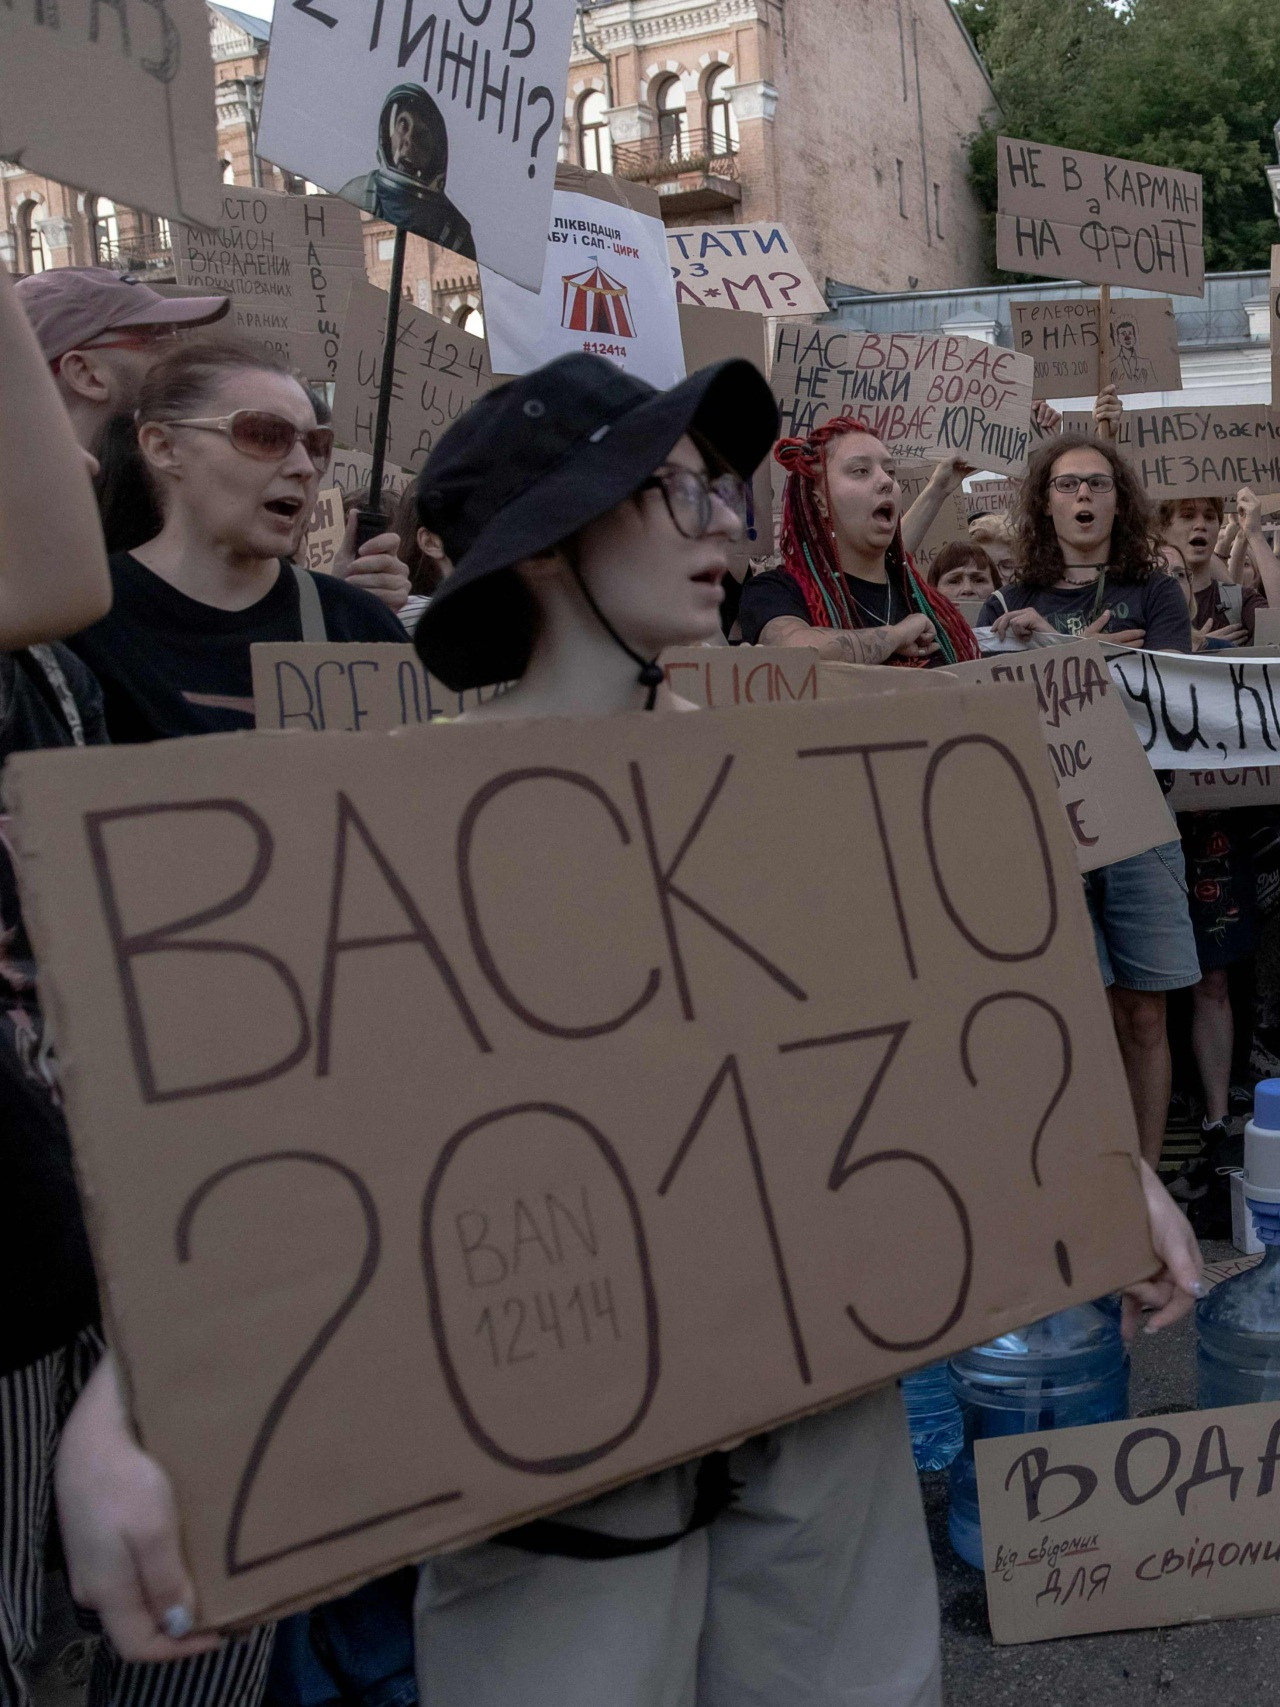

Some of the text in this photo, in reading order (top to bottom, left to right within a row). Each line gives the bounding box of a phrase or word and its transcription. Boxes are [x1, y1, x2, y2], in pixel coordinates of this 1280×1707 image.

[1006, 145, 1198, 214] НЕ В КАРМАН
[554, 217, 622, 241] ЛІКВІДАЦІЯ
[582, 235, 605, 250] САП
[613, 242, 640, 259] ЦИРК
[1016, 216, 1196, 277] НА ФРОНТ
[188, 248, 291, 276] ВКРАДЕНИХ
[583, 341, 627, 357] #12414
[777, 328, 1016, 385] НАС ВБИВАЄ
[795, 366, 831, 399] НЕ
[927, 374, 1018, 412] ВОРОГ
[777, 398, 829, 438] НАС
[83, 733, 1058, 1105] BACK TO
[456, 1184, 598, 1290] BAN
[176, 989, 1072, 1578] 2013?
[472, 1275, 623, 1369] 12414
[1035, 1564, 1112, 1607] ДЛЯ
